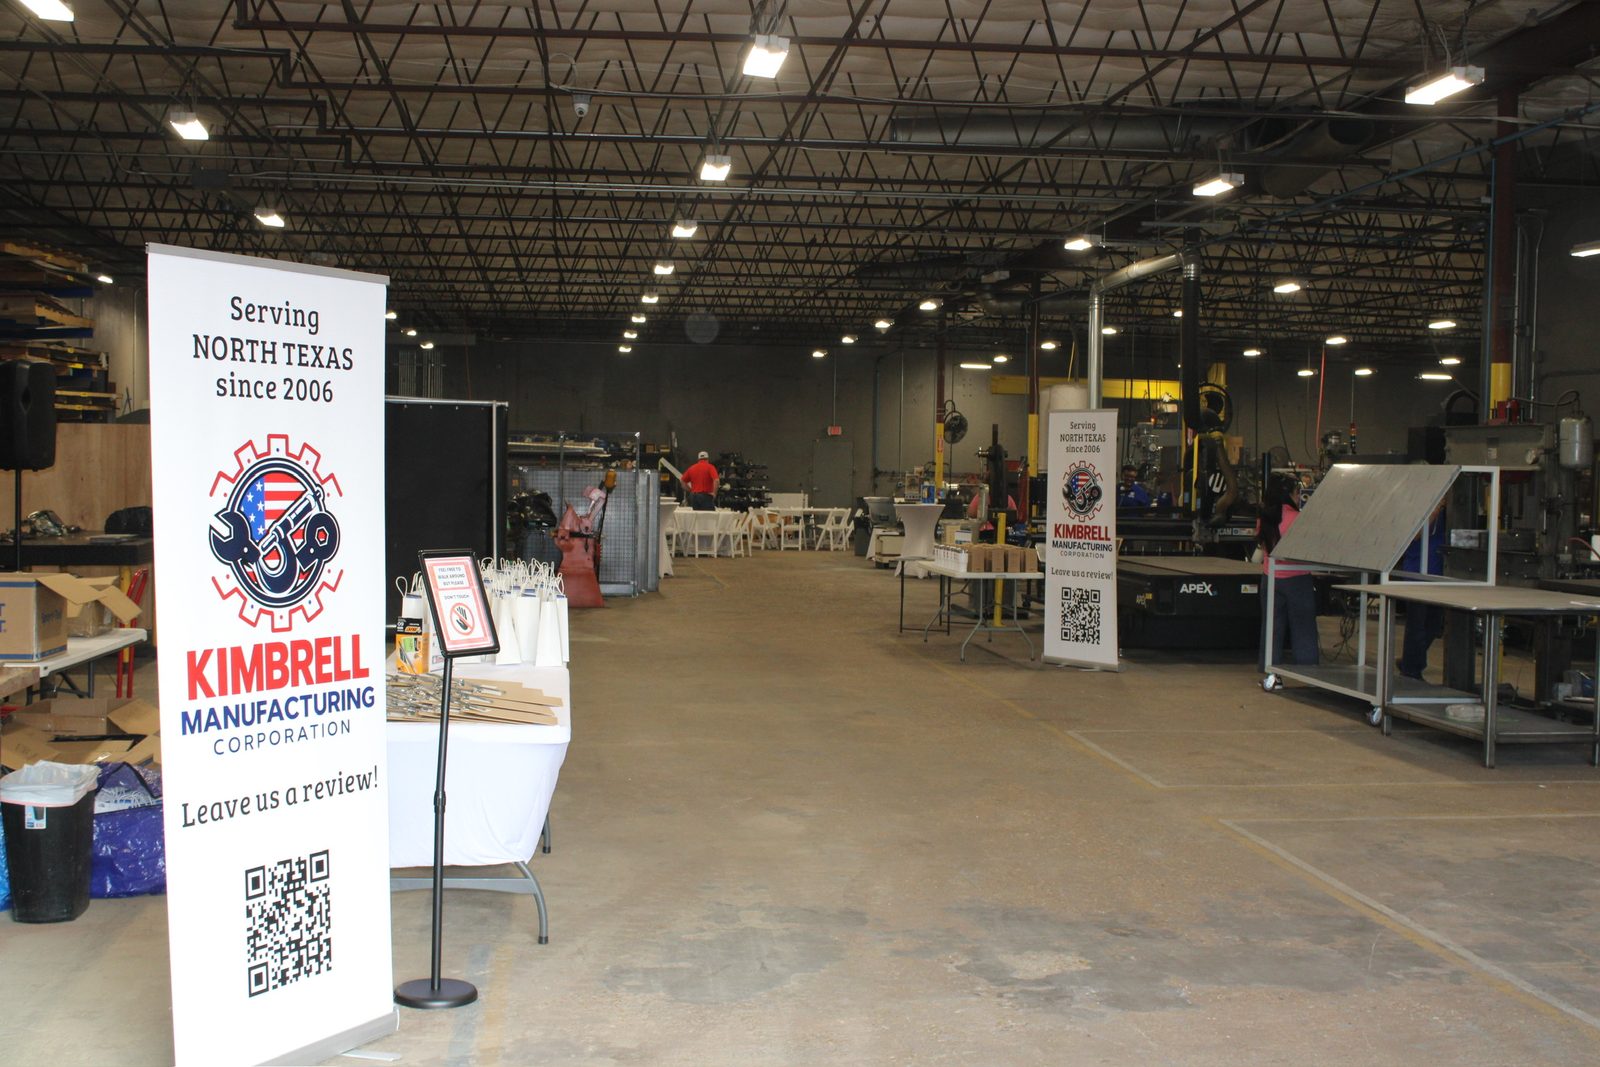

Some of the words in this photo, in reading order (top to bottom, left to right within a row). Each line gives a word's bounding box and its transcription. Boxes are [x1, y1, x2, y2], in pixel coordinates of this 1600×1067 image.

[230, 296, 320, 335] Serving
[192, 334, 278, 365] NORTH
[282, 342, 354, 371] TEXAS
[216, 372, 277, 400] since
[283, 377, 333, 403] 2006
[1070, 421, 1096, 431] Serving
[1060, 433, 1083, 442] NORTH
[1084, 433, 1106, 442] TEXAS
[1066, 444, 1083, 453] since
[1084, 445, 1101, 453] 2006
[1054, 523, 1111, 541] KIMBRELL
[1052, 540, 1113, 552] MANUFACTURING
[1060, 550, 1105, 559] CORPORATION
[1051, 567, 1070, 576] Leave
[1086, 571, 1113, 580] review!
[1180, 582, 1213, 596] APEX
[187, 634, 370, 701] KIMBRELL
[181, 686, 375, 736] MANUFACTURING
[213, 719, 351, 755] CORPORATION
[181, 796, 251, 828] Leave
[256, 791, 279, 813] us
[287, 786, 298, 806] a
[302, 765, 378, 795] review!
